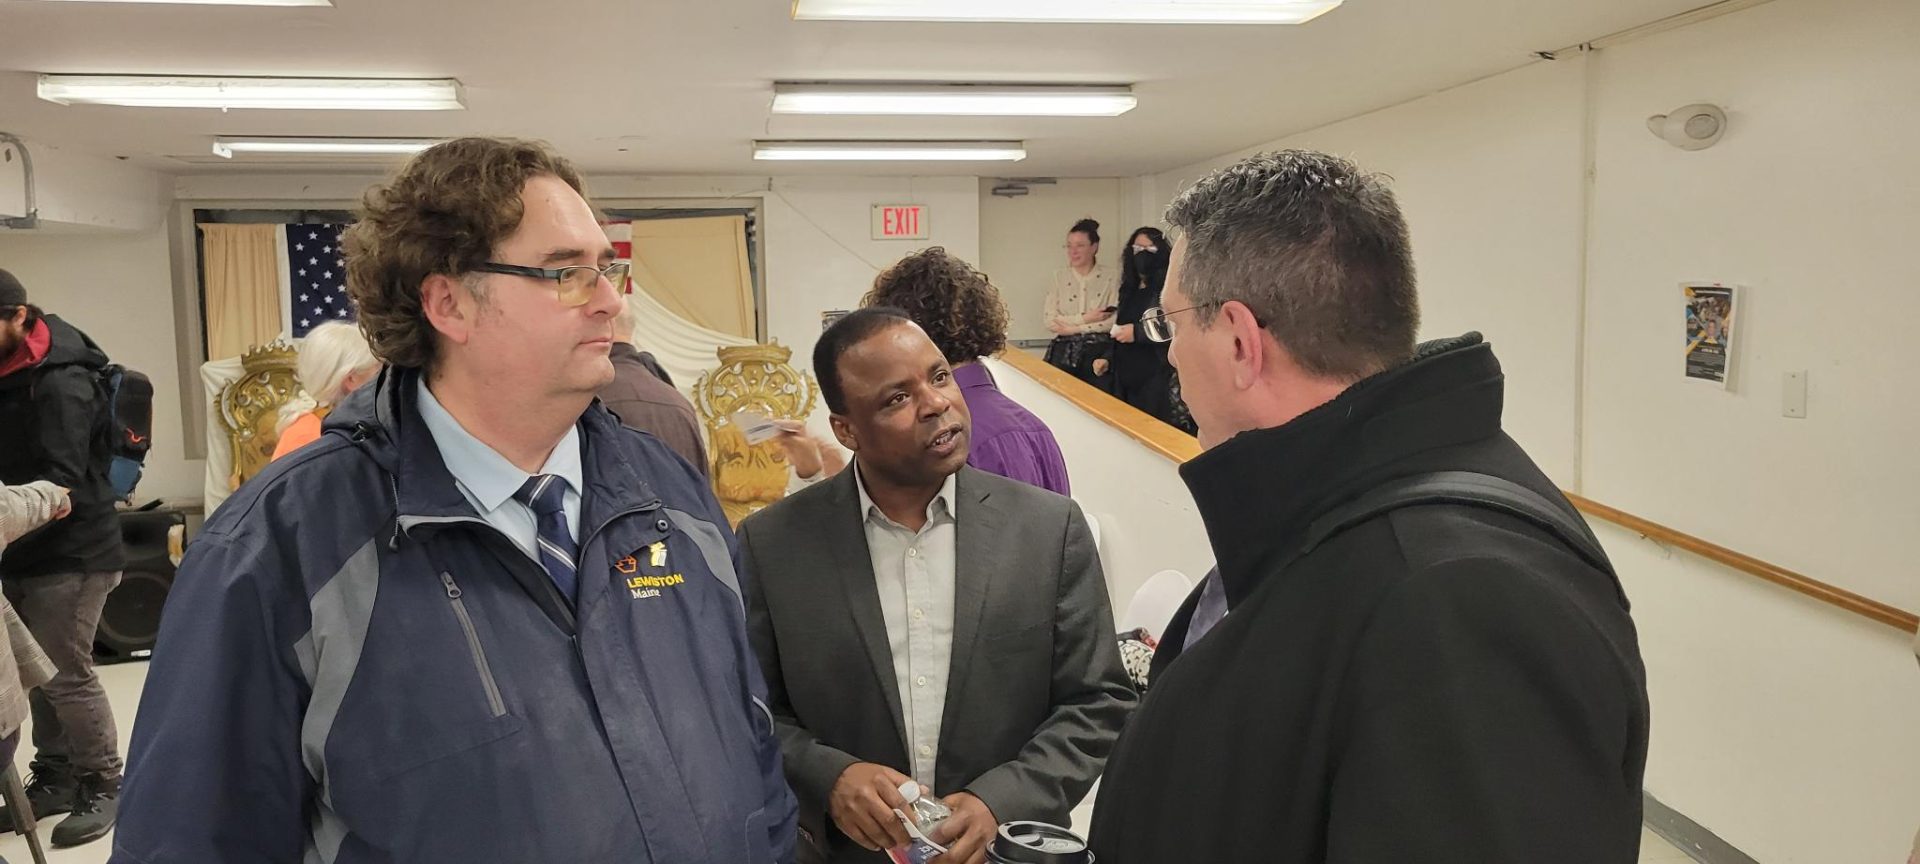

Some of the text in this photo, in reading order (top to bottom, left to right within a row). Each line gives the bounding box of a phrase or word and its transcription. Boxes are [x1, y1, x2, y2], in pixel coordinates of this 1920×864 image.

[883, 207, 919, 235] EXIT
[627, 573, 684, 589] LEWISTON
[630, 587, 661, 599] Maine
